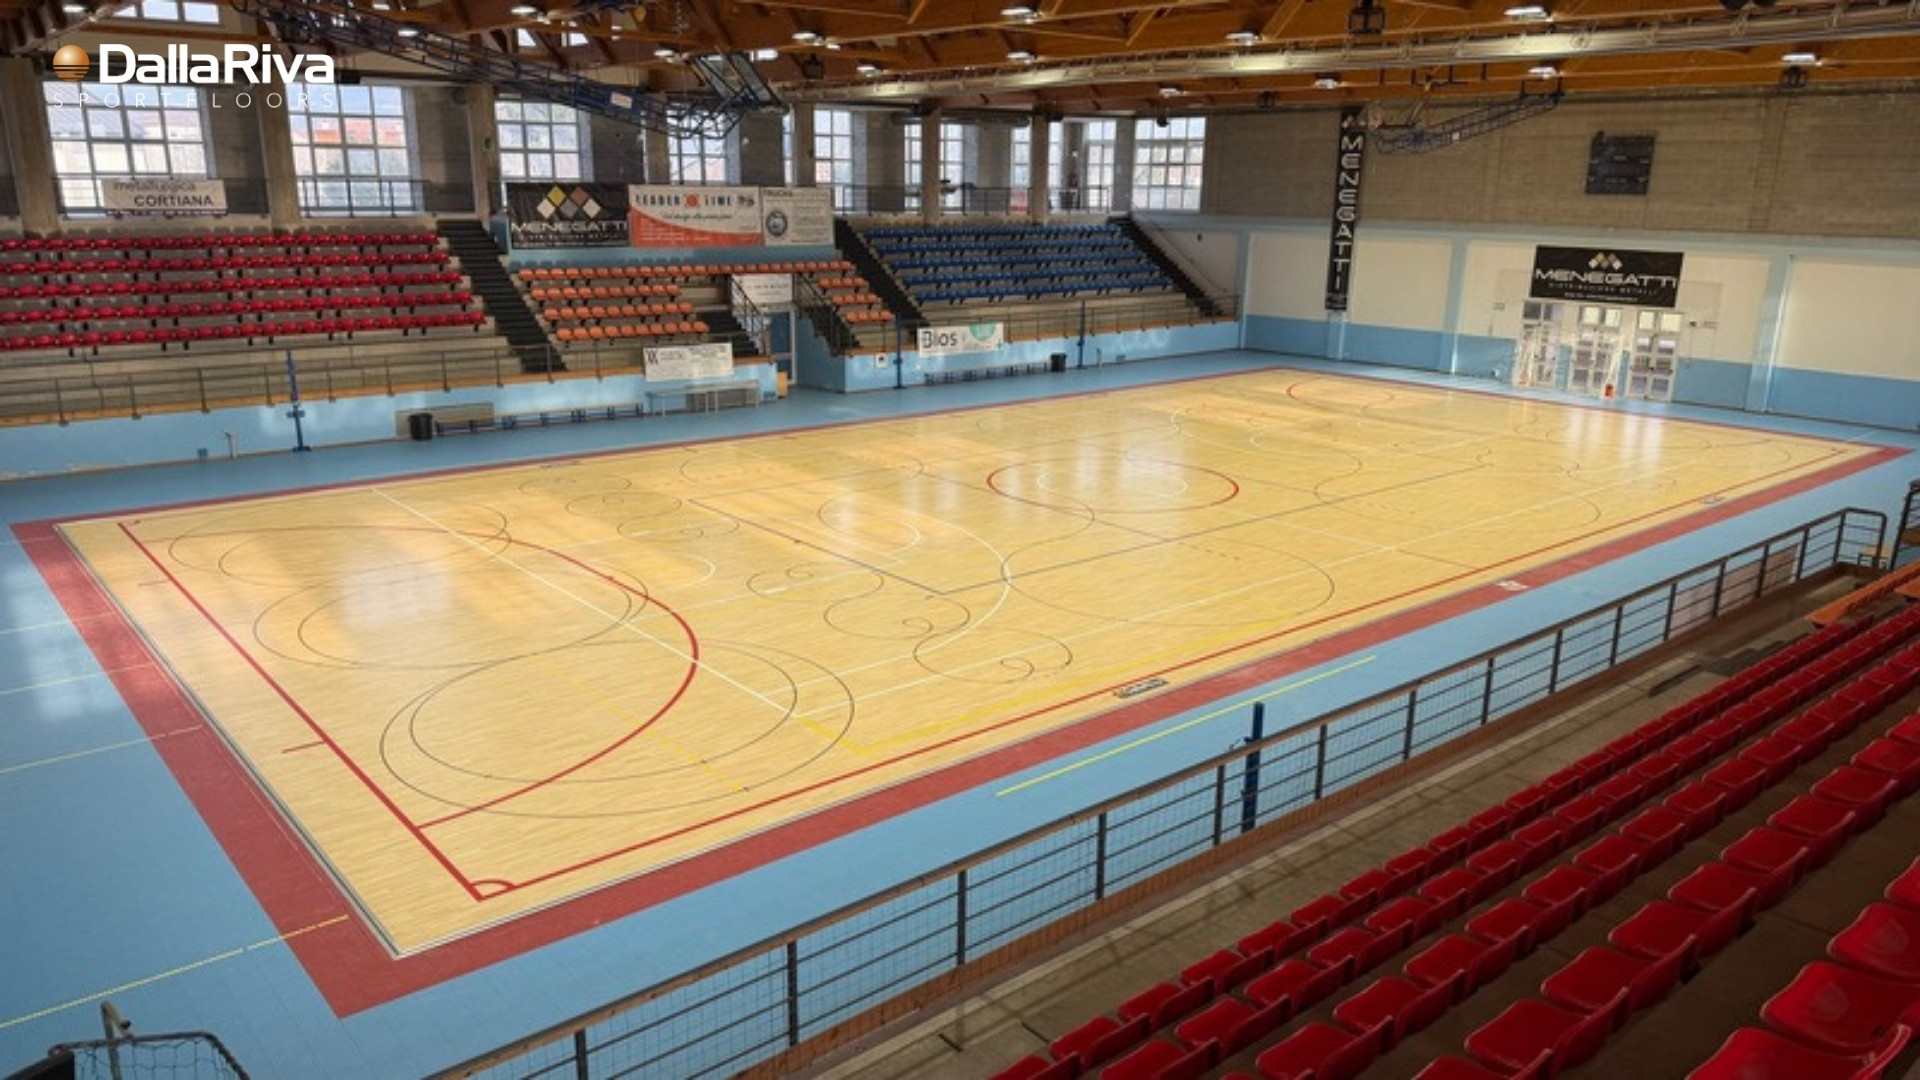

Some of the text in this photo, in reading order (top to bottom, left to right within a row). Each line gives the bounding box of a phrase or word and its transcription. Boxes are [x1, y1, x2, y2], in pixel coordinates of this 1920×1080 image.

[133, 194, 214, 208] CORTIANA
[1333, 135, 1364, 290] MENEGATTI
[511, 221, 628, 234] MENEGATTI
[1535, 268, 1678, 289] MENEGATTI
